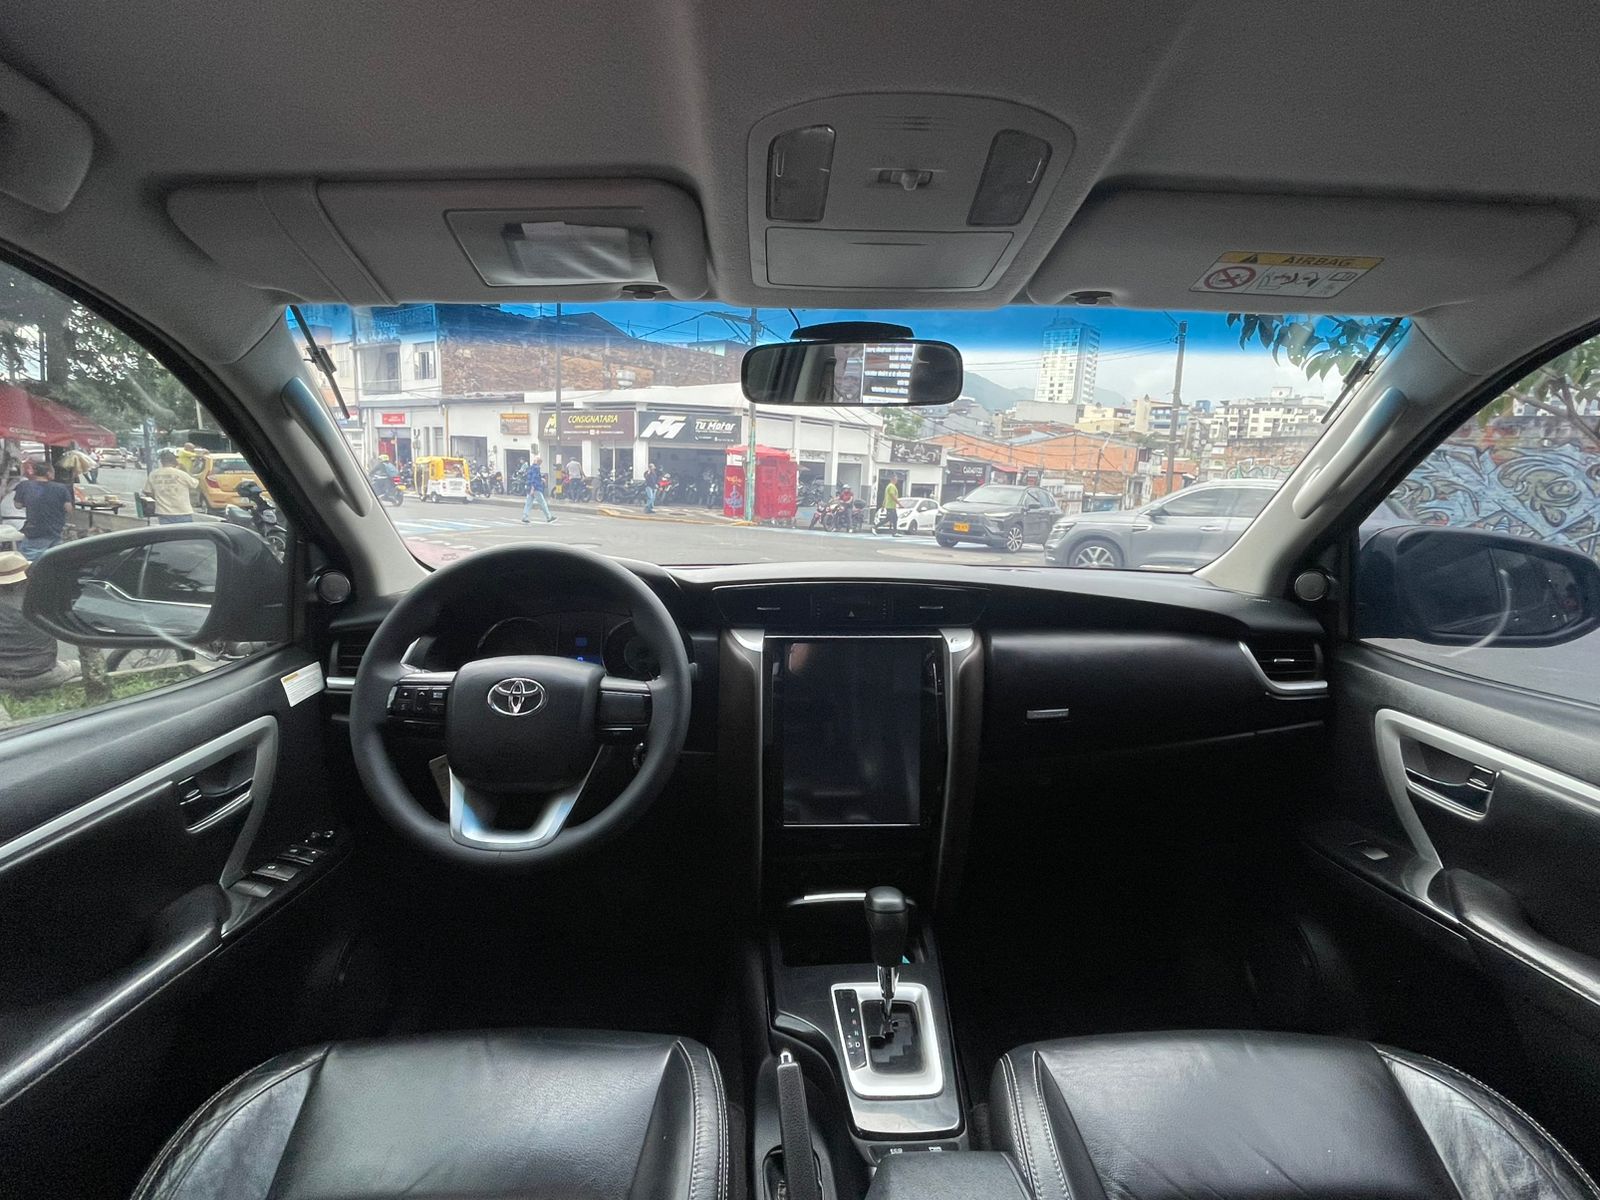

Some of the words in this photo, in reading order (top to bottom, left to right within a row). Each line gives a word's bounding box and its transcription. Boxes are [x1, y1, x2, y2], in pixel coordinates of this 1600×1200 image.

[1282, 256, 1355, 267] AIRBAG
[568, 414, 619, 424] CONSIGNATARIA
[707, 421, 736, 431] Motor
